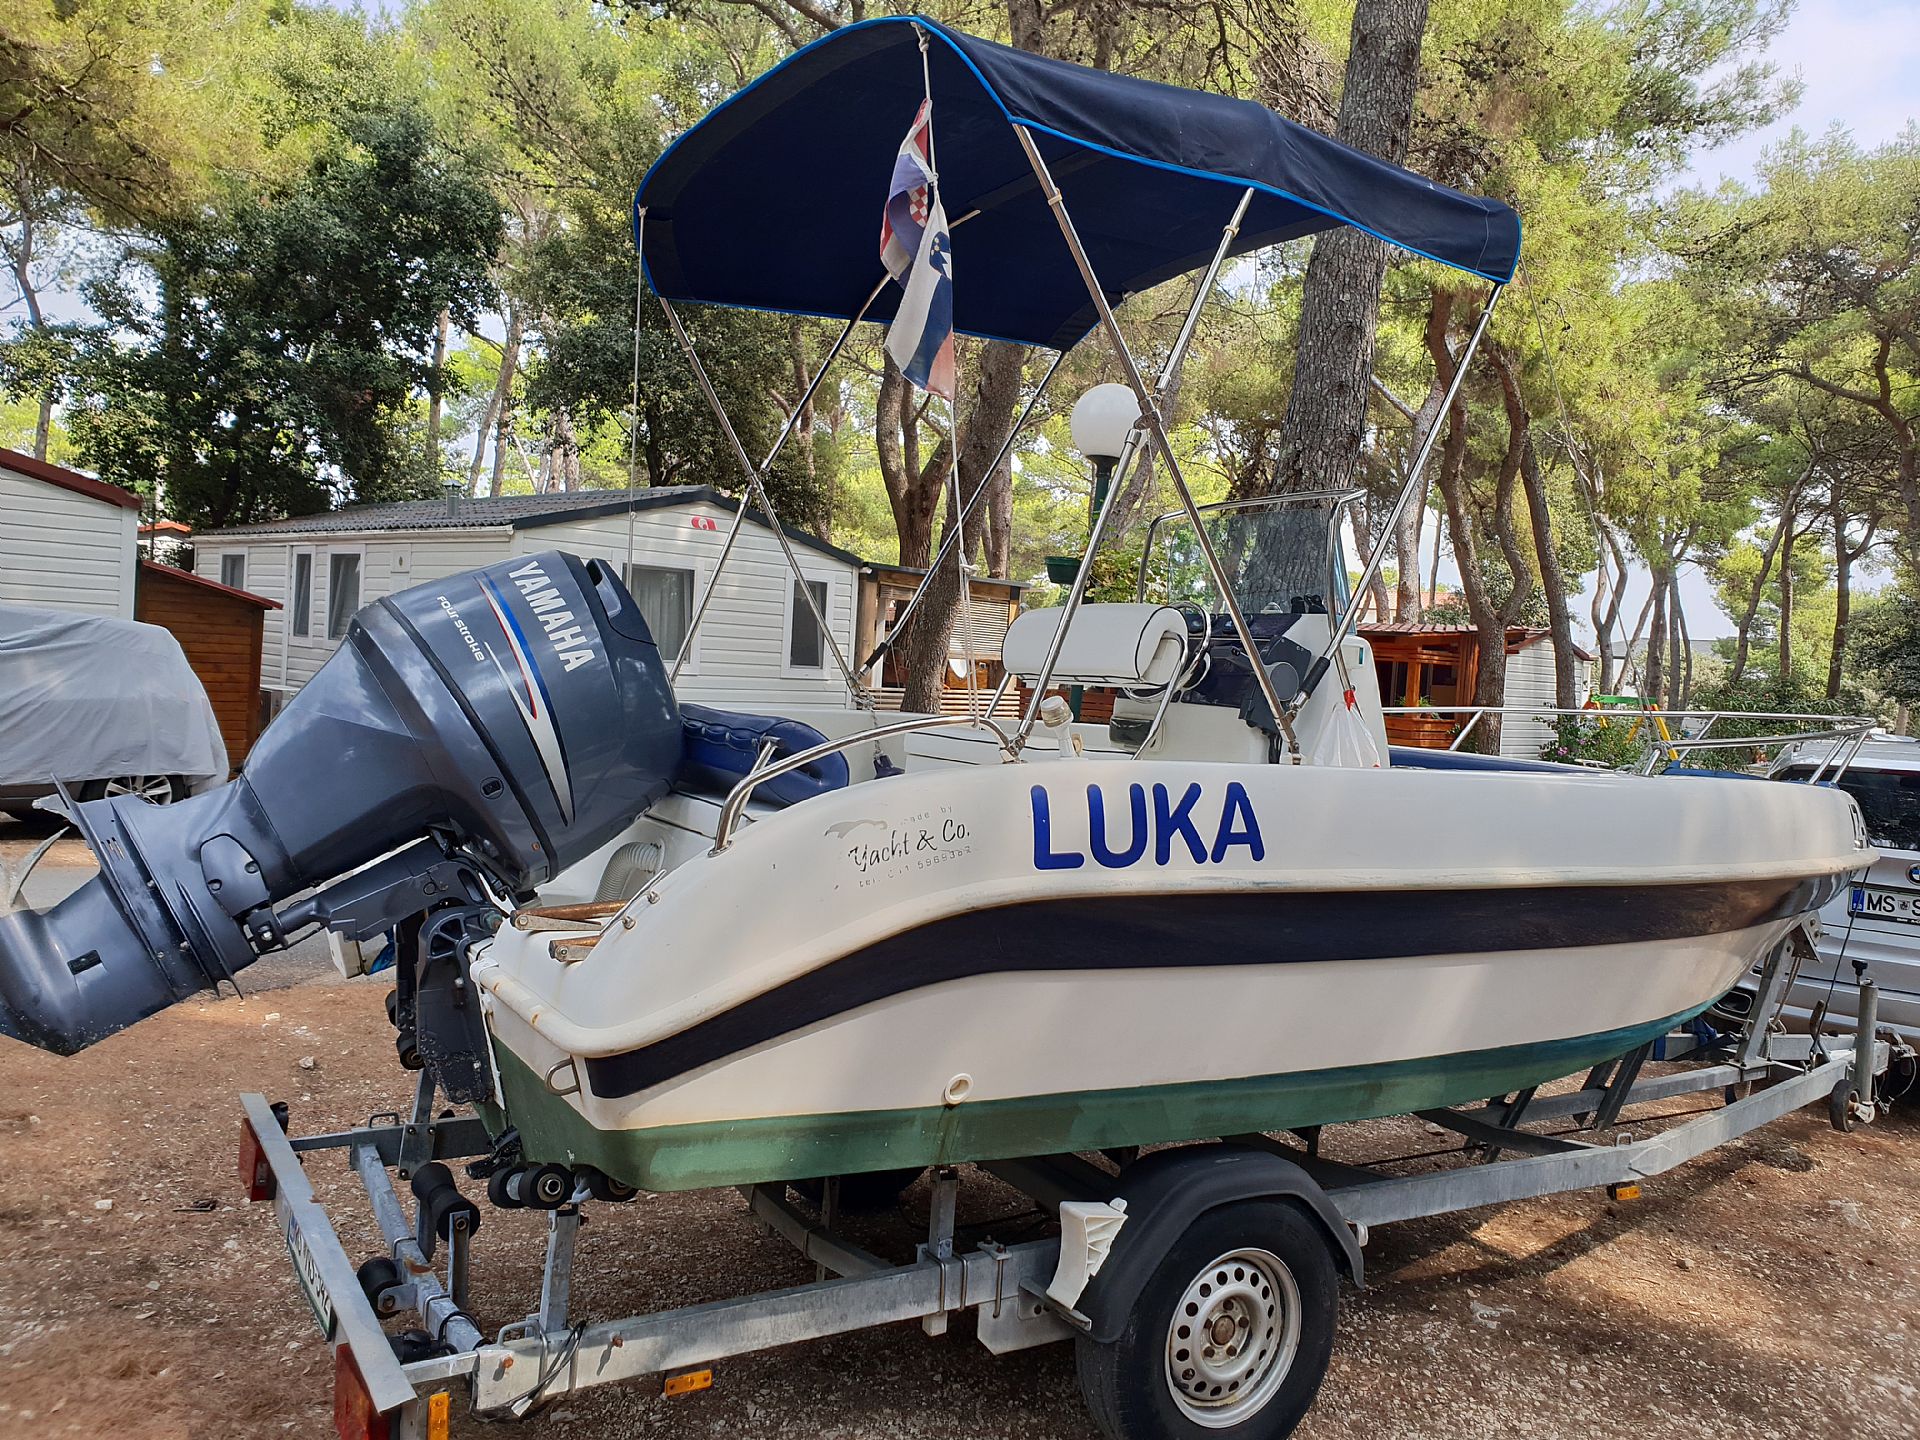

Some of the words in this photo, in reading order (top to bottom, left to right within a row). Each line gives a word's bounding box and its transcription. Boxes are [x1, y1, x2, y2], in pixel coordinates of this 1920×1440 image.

[509, 561, 596, 673] YAMAHA
[848, 830, 909, 872] Yacht
[917, 829, 938, 851] &
[942, 819, 970, 842] Co.
[1031, 782, 1265, 870] LUKA
[1867, 892, 1896, 913] MS
